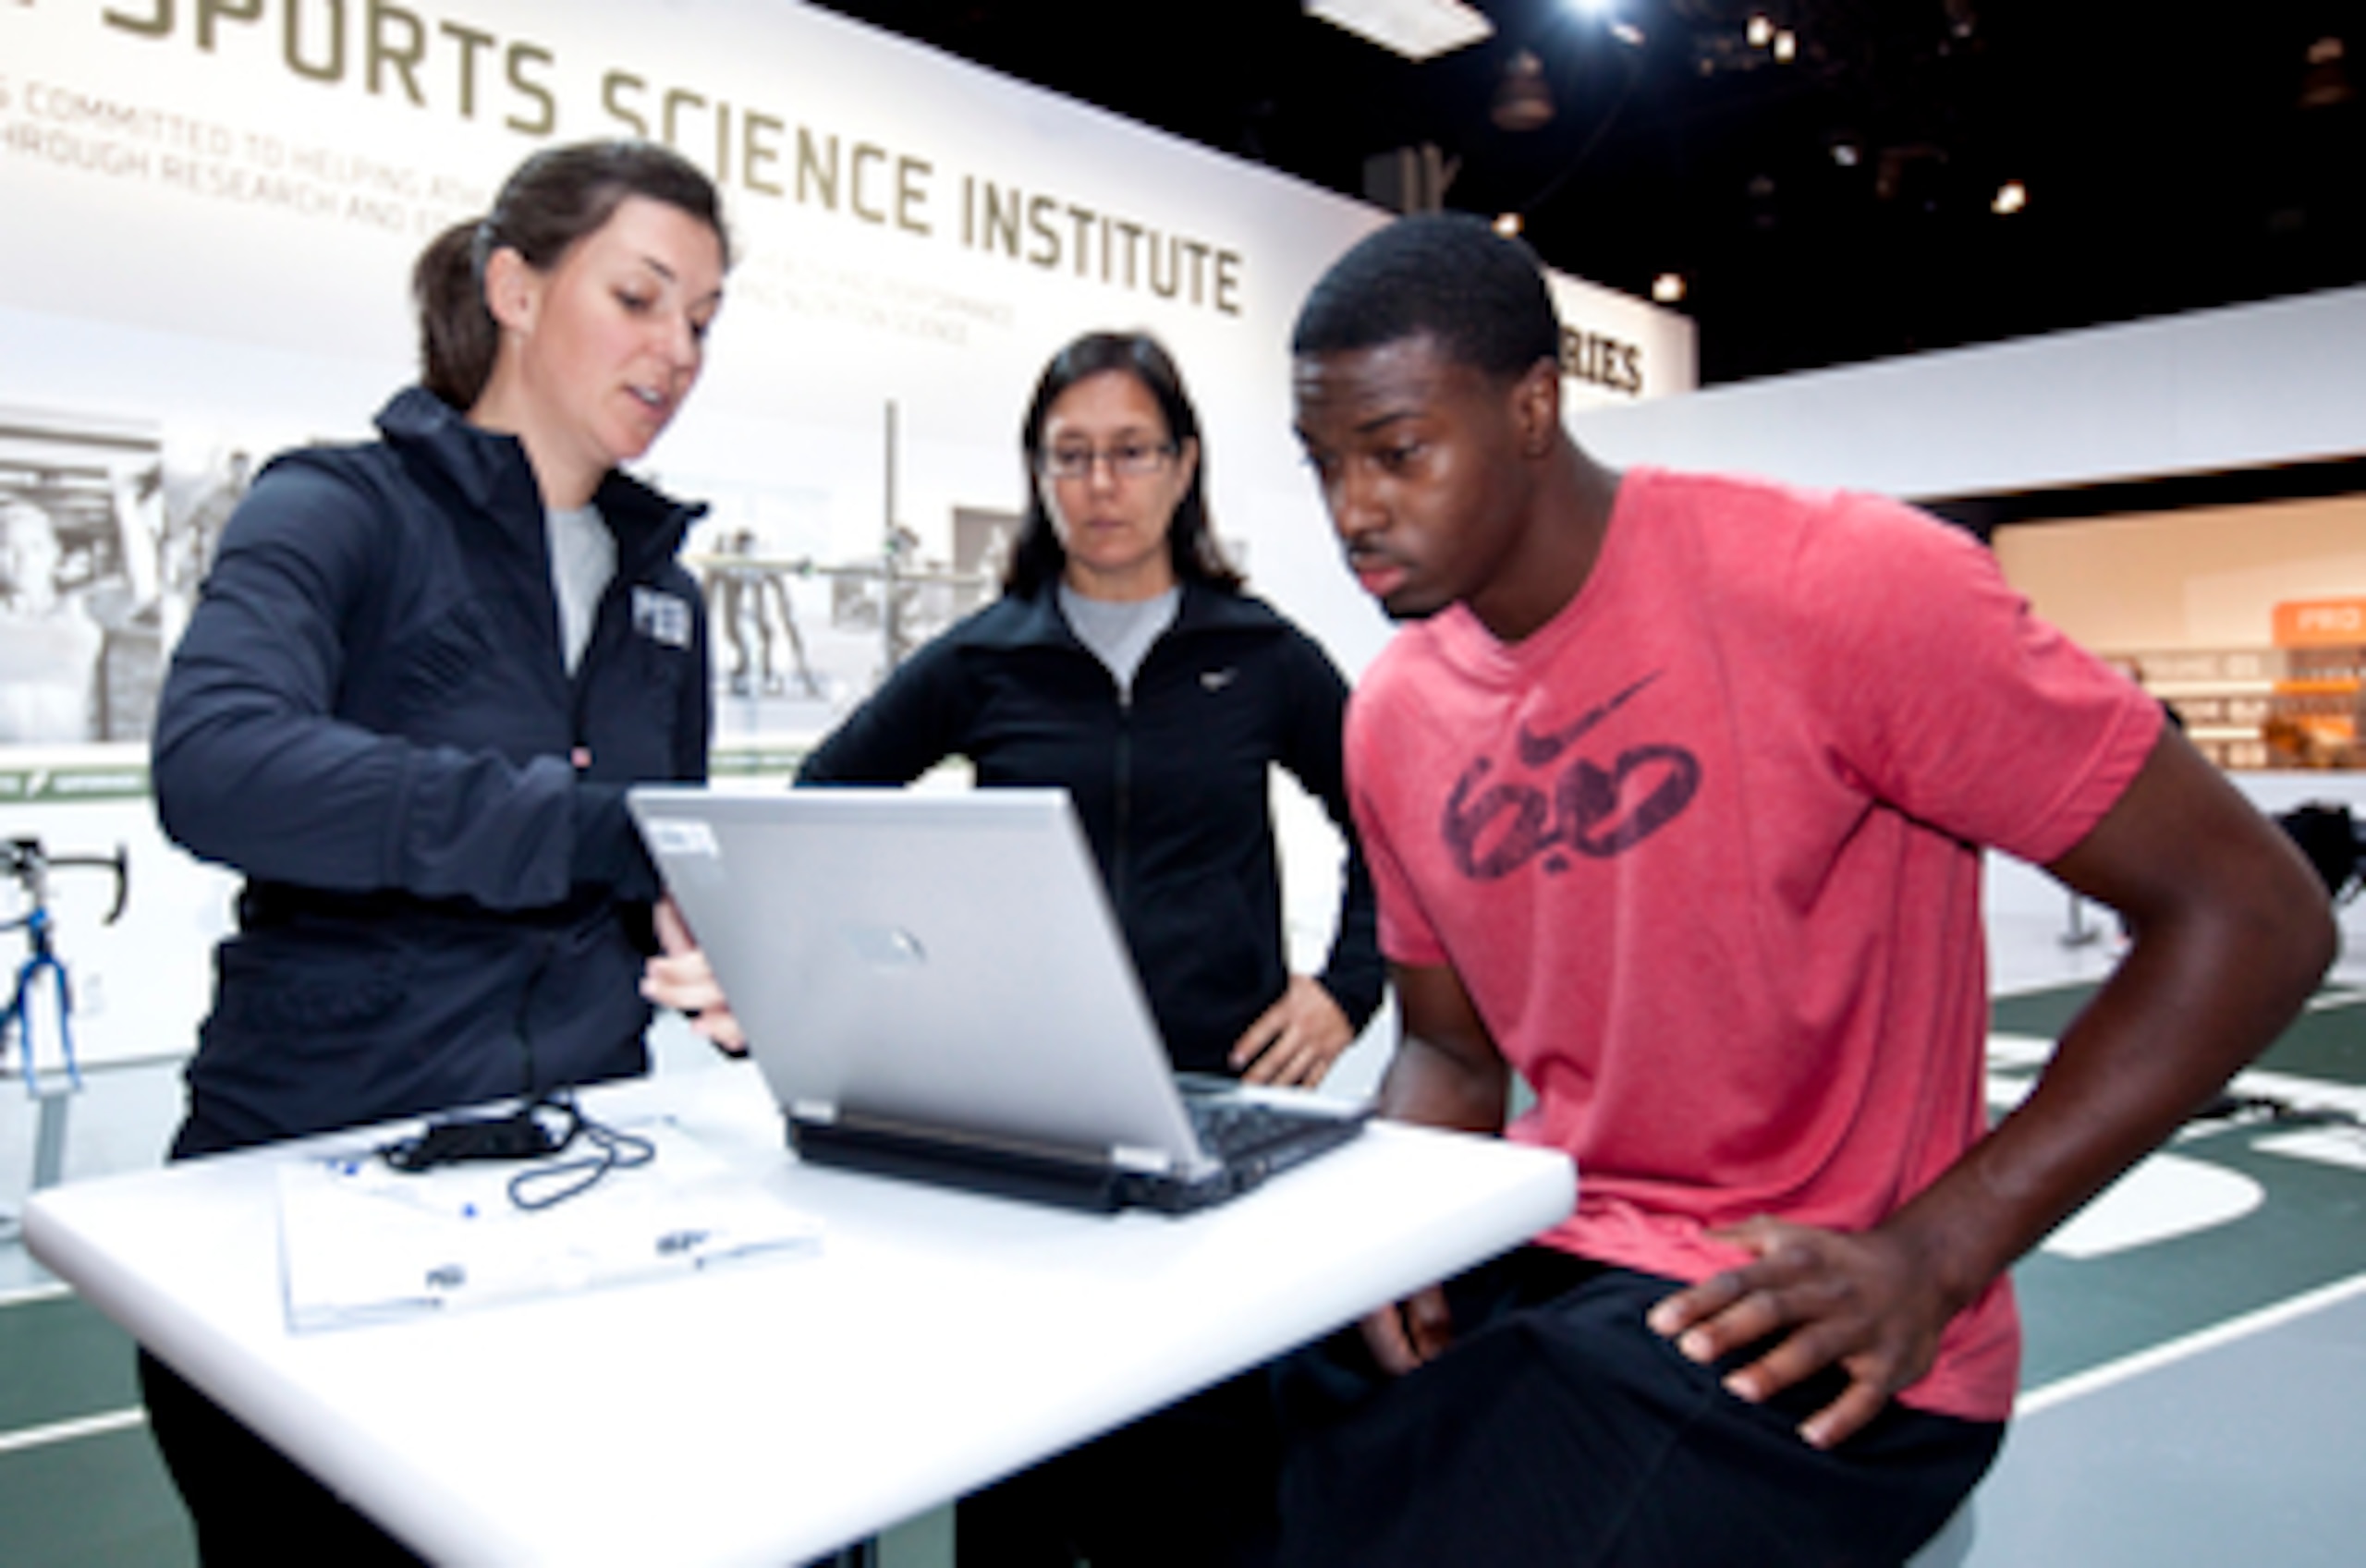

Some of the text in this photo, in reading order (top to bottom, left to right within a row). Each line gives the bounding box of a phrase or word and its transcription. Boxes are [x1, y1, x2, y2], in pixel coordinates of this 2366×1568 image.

[24, 79, 231, 158] COMMITTED
[245, 130, 285, 169] TO
[0, 121, 149, 180] HROUGH
[161, 152, 338, 217] RESEARCH
[345, 194, 407, 234] AND
[601, 68, 933, 237] SCIENCE
[959, 176, 1244, 317] INSTITUTE
[1558, 324, 1642, 398] RIES
